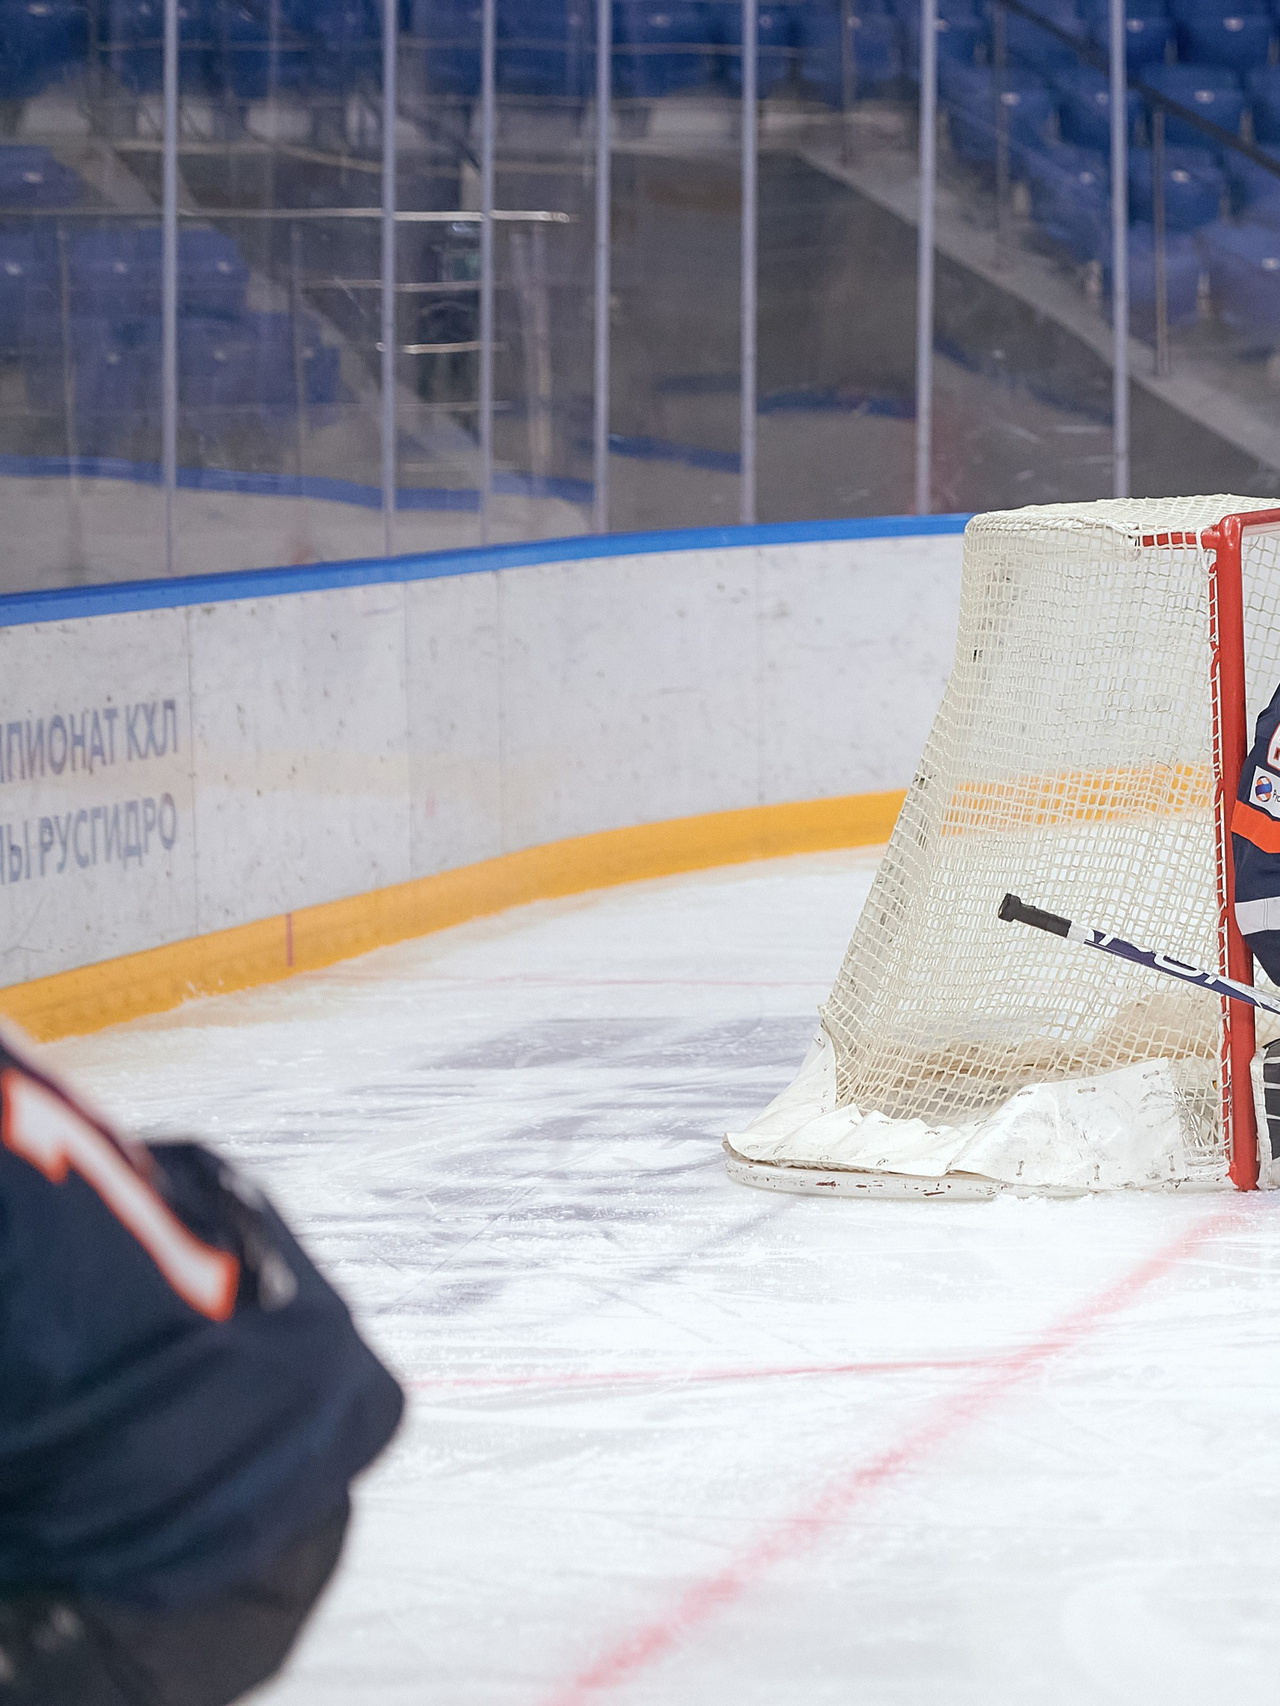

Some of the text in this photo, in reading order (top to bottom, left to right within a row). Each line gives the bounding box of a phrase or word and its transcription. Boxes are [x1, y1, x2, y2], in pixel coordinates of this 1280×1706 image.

[0, 698, 178, 785] ПИОНАТ КХЛ
[0, 791, 177, 886] Ы РУСГИДРО
